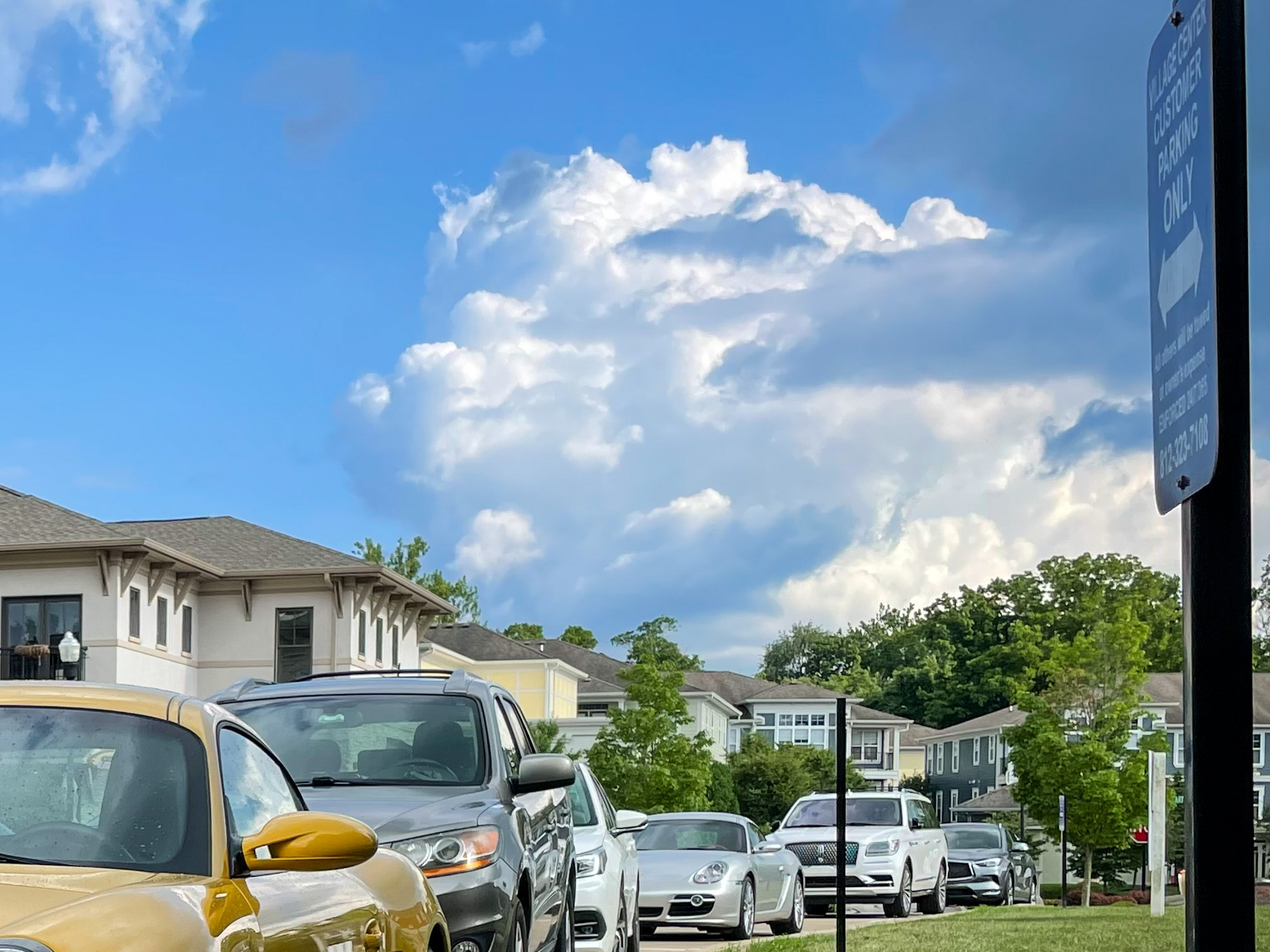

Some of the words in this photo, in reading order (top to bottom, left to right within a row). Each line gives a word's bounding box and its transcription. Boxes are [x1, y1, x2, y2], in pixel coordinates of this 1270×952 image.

[1148, 43, 1177, 111] VILLAGE
[1177, 0, 1208, 65] CENTER
[1153, 46, 1202, 145] CUSTOMER
[1158, 102, 1198, 187] PARKING
[1163, 156, 1194, 234] ONLY
[1158, 397, 1186, 434] ENFORCED
[1159, 413, 1209, 479] 812-323-7108
